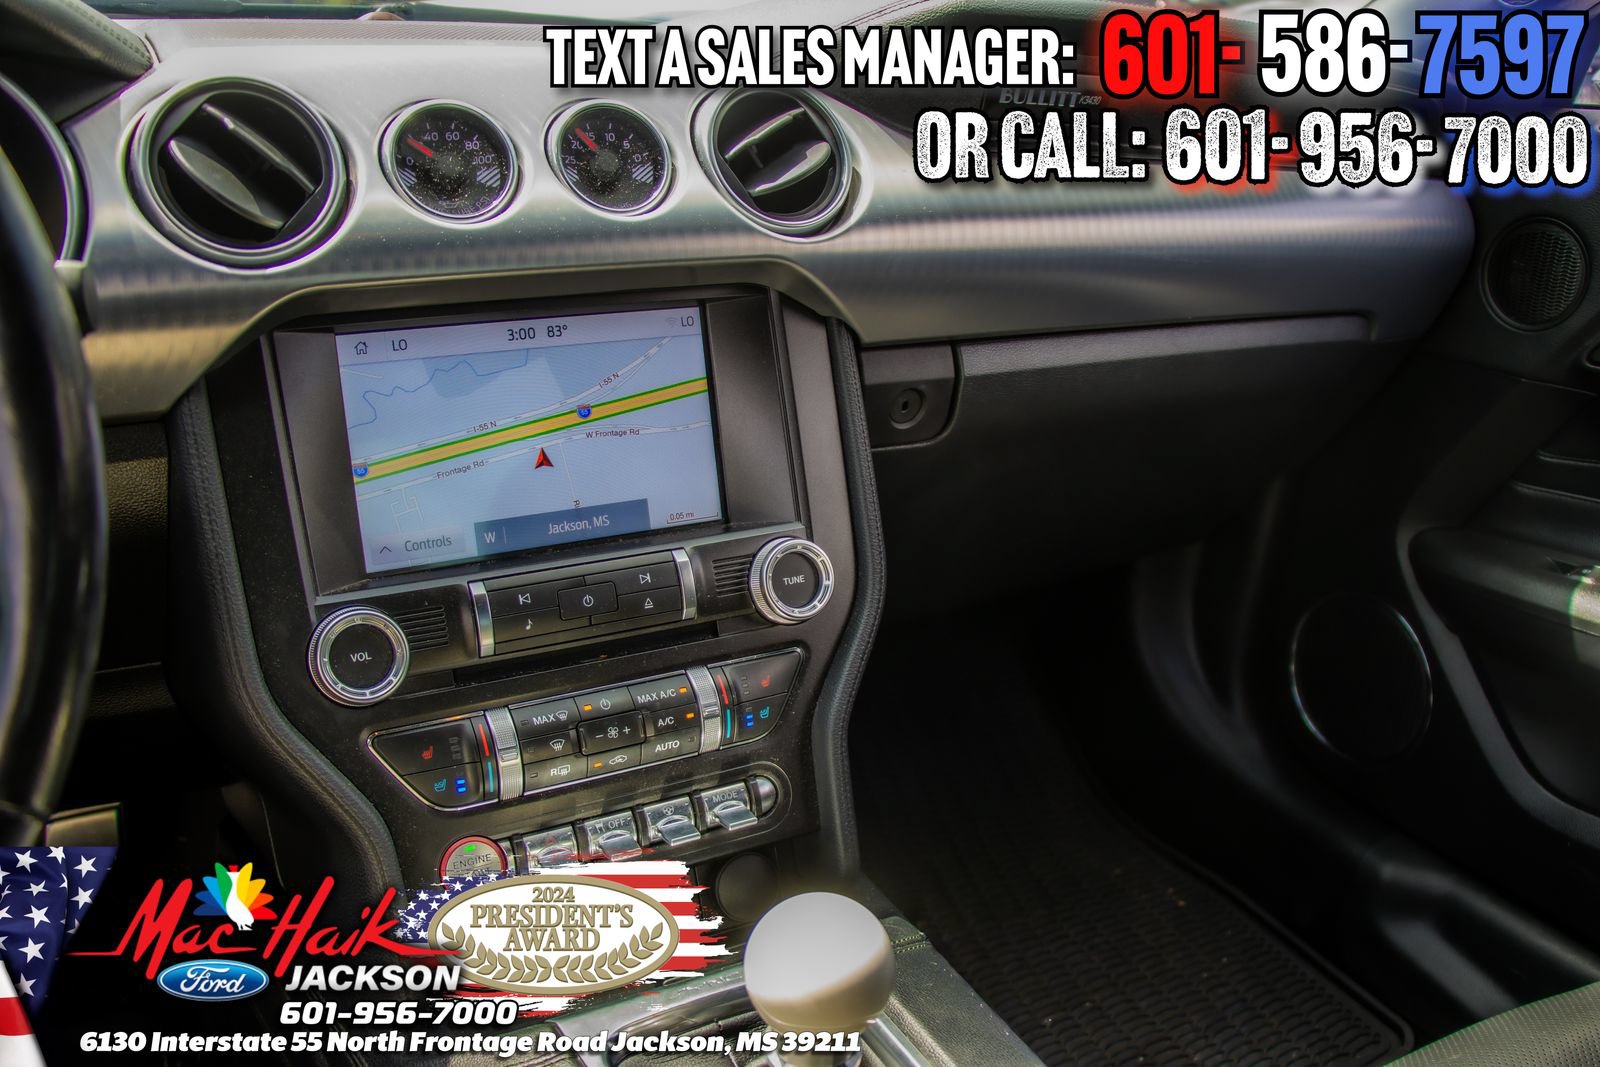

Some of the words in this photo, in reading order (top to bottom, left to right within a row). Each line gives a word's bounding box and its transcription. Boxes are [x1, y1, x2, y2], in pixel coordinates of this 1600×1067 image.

[999, 88, 1082, 107] BULLITT
[424, 132, 438, 141] 40
[446, 132, 460, 140] 60
[605, 133, 615, 141] 10
[464, 140, 480, 150] 80
[623, 141, 630, 149] 5
[406, 156, 414, 166] 0
[565, 155, 576, 165] 25
[680, 316, 695, 327] LO
[507, 327, 536, 341] 3:00
[391, 339, 408, 351] LO
[585, 431, 594, 439] W
[595, 430, 627, 439] Frontage
[628, 428, 640, 436] Rd
[437, 464, 471, 480] Frontage
[472, 459, 485, 468] Rd
[548, 519, 592, 534] Jackson,
[593, 515, 610, 527] MS
[484, 531, 496, 543] W
[405, 535, 452, 552] Controls
[783, 575, 806, 586] TUNE
[350, 651, 372, 663] VOL
[638, 692, 659, 704] MAX
[659, 688, 677, 700] A/C
[532, 713, 555, 726] MAX
[657, 716, 675, 727] A/C
[655, 740, 680, 752] AUTO
[712, 790, 738, 803] MODE
[608, 817, 626, 829] OFF
[453, 853, 492, 869] ENGINE
